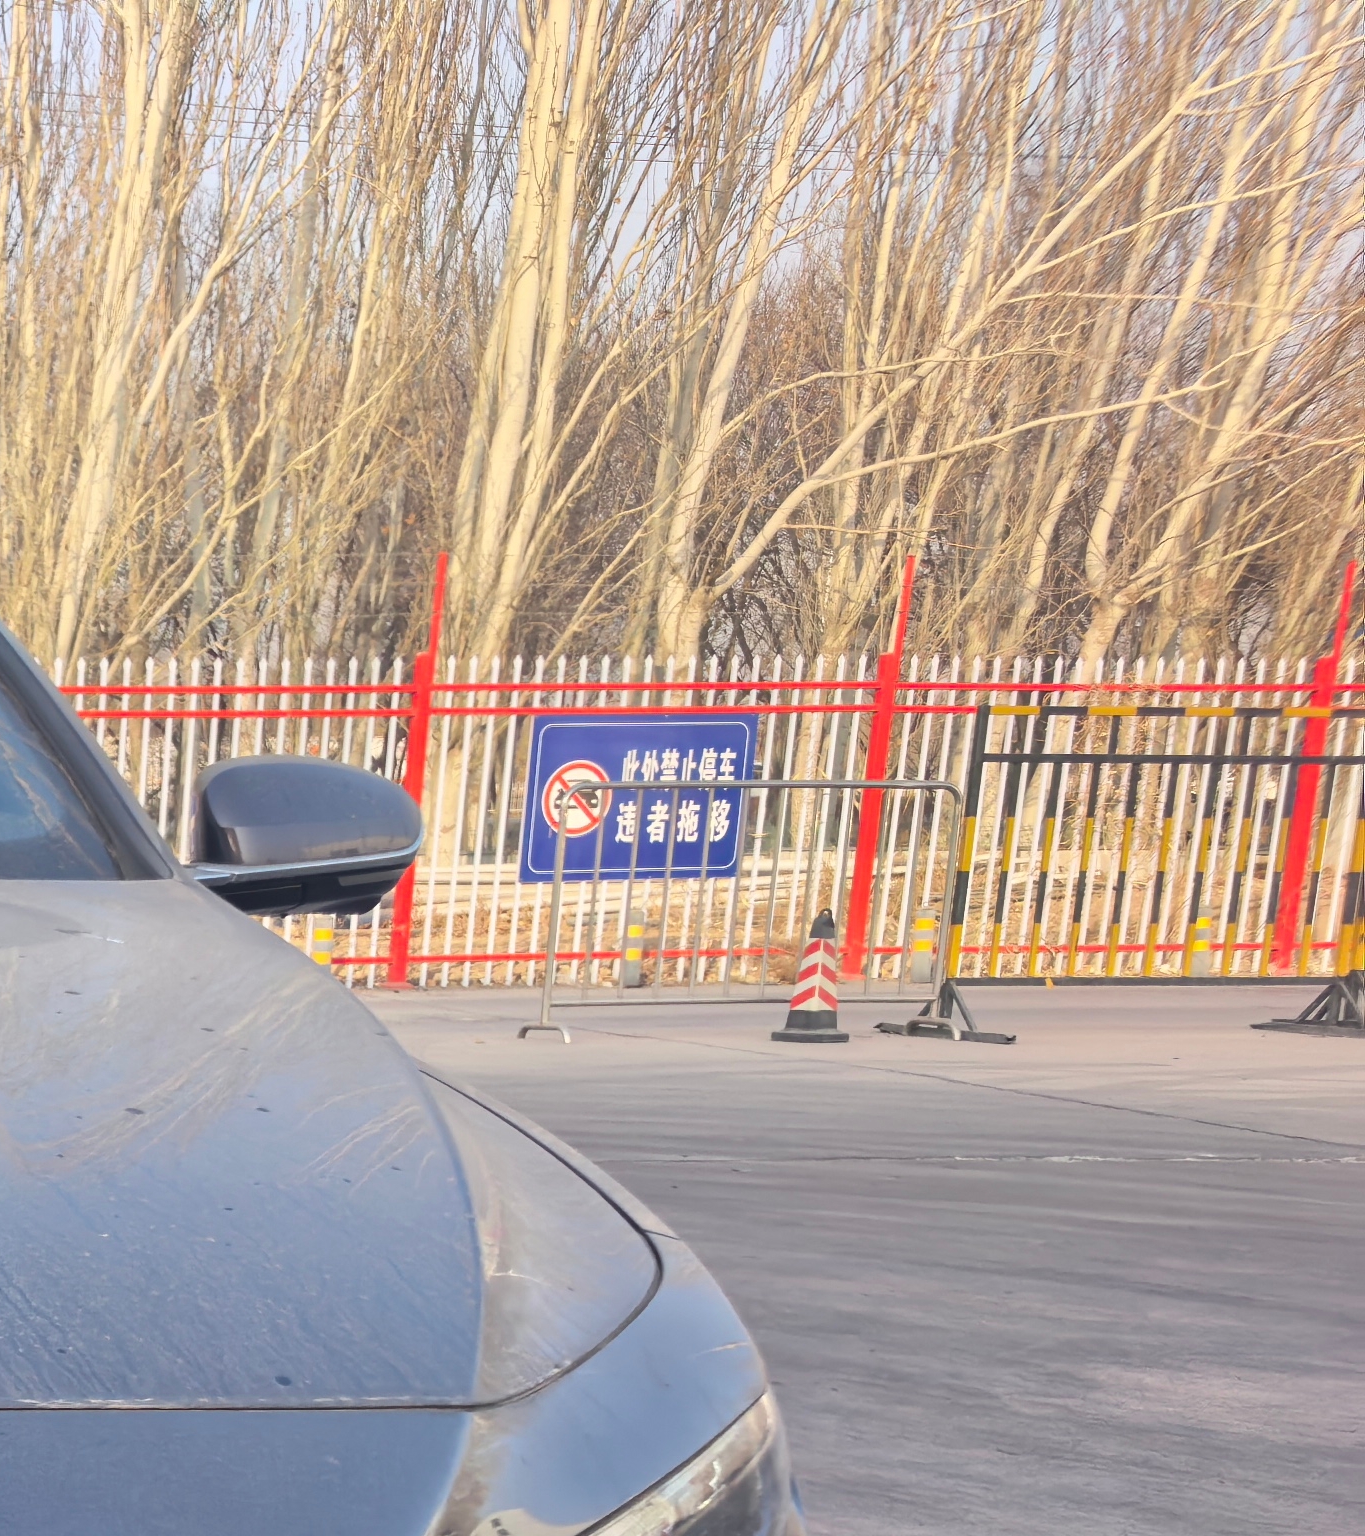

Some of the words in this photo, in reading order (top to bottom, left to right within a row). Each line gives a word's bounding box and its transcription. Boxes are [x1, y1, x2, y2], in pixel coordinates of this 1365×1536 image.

[621, 747, 737, 791] 此处禁止停车
[615, 799, 731, 843] 违者拖移
